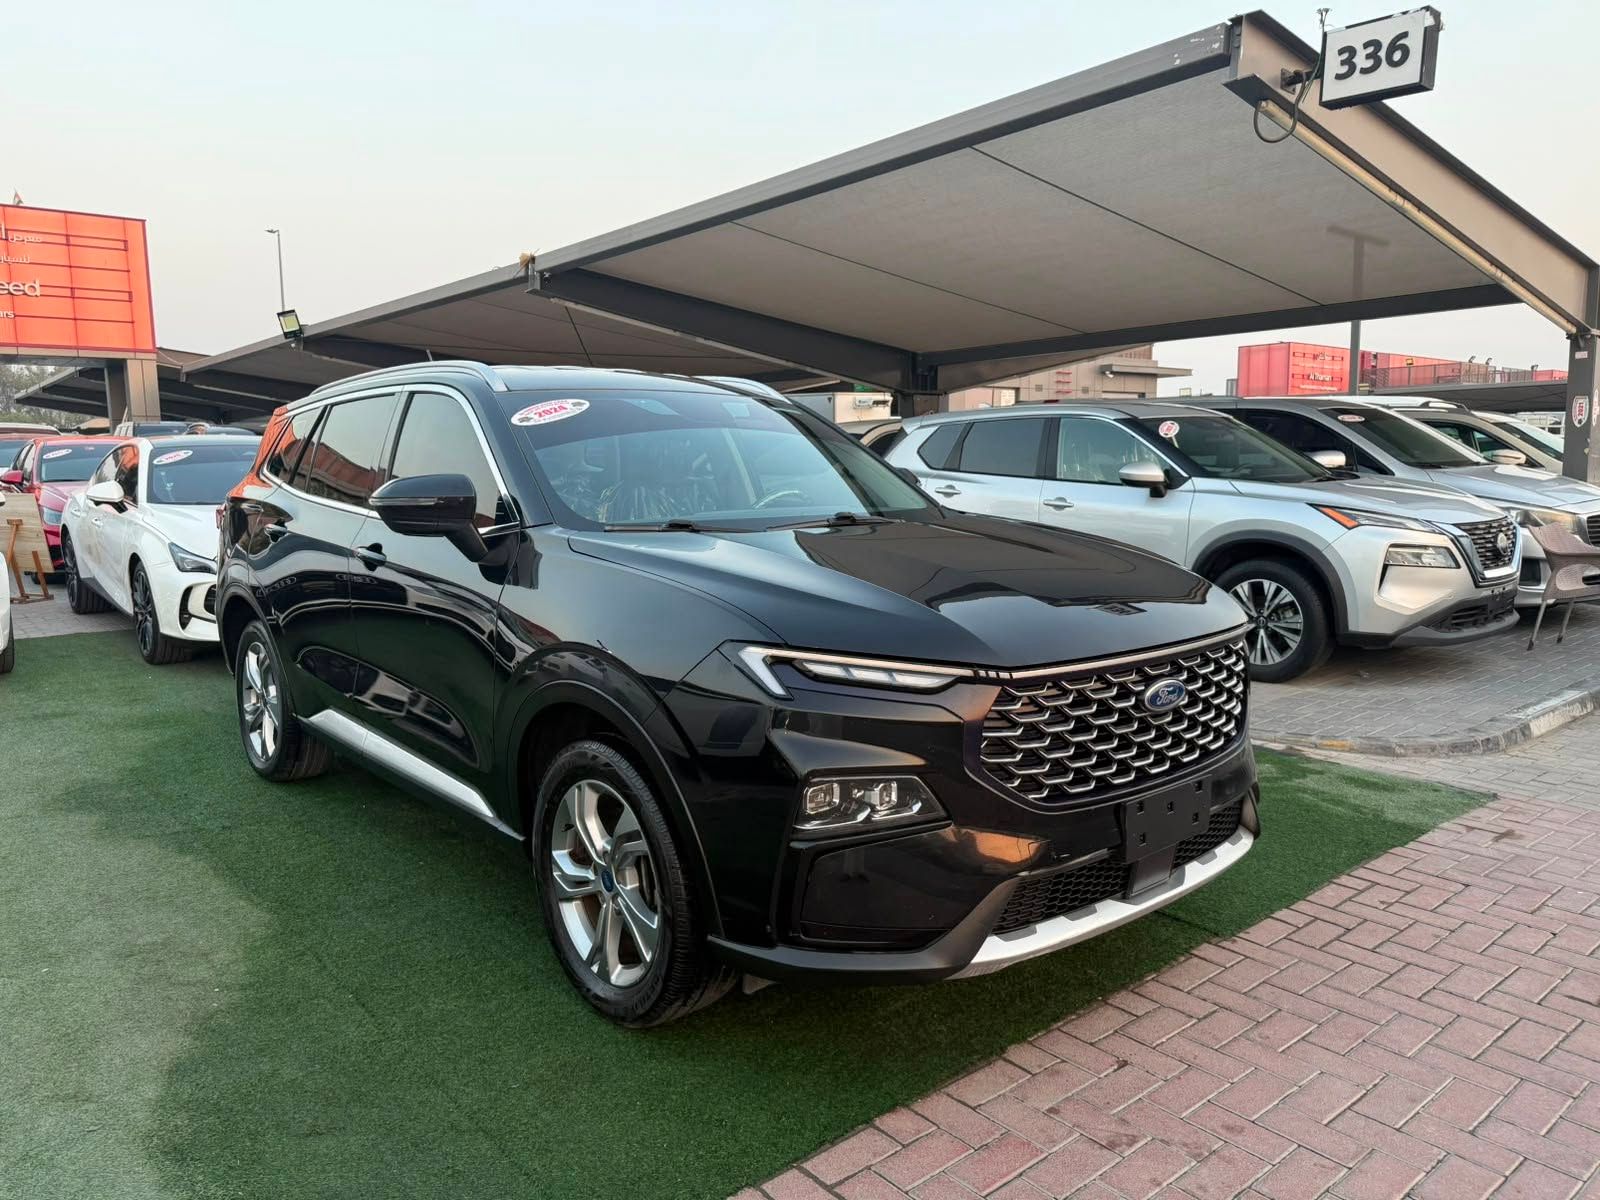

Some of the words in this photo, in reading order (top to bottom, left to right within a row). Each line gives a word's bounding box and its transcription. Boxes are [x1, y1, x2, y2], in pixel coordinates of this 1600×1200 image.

[1334, 30, 1411, 81] 336
[533, 405, 569, 418] 2024
[1156, 686, 1179, 705] Ford
